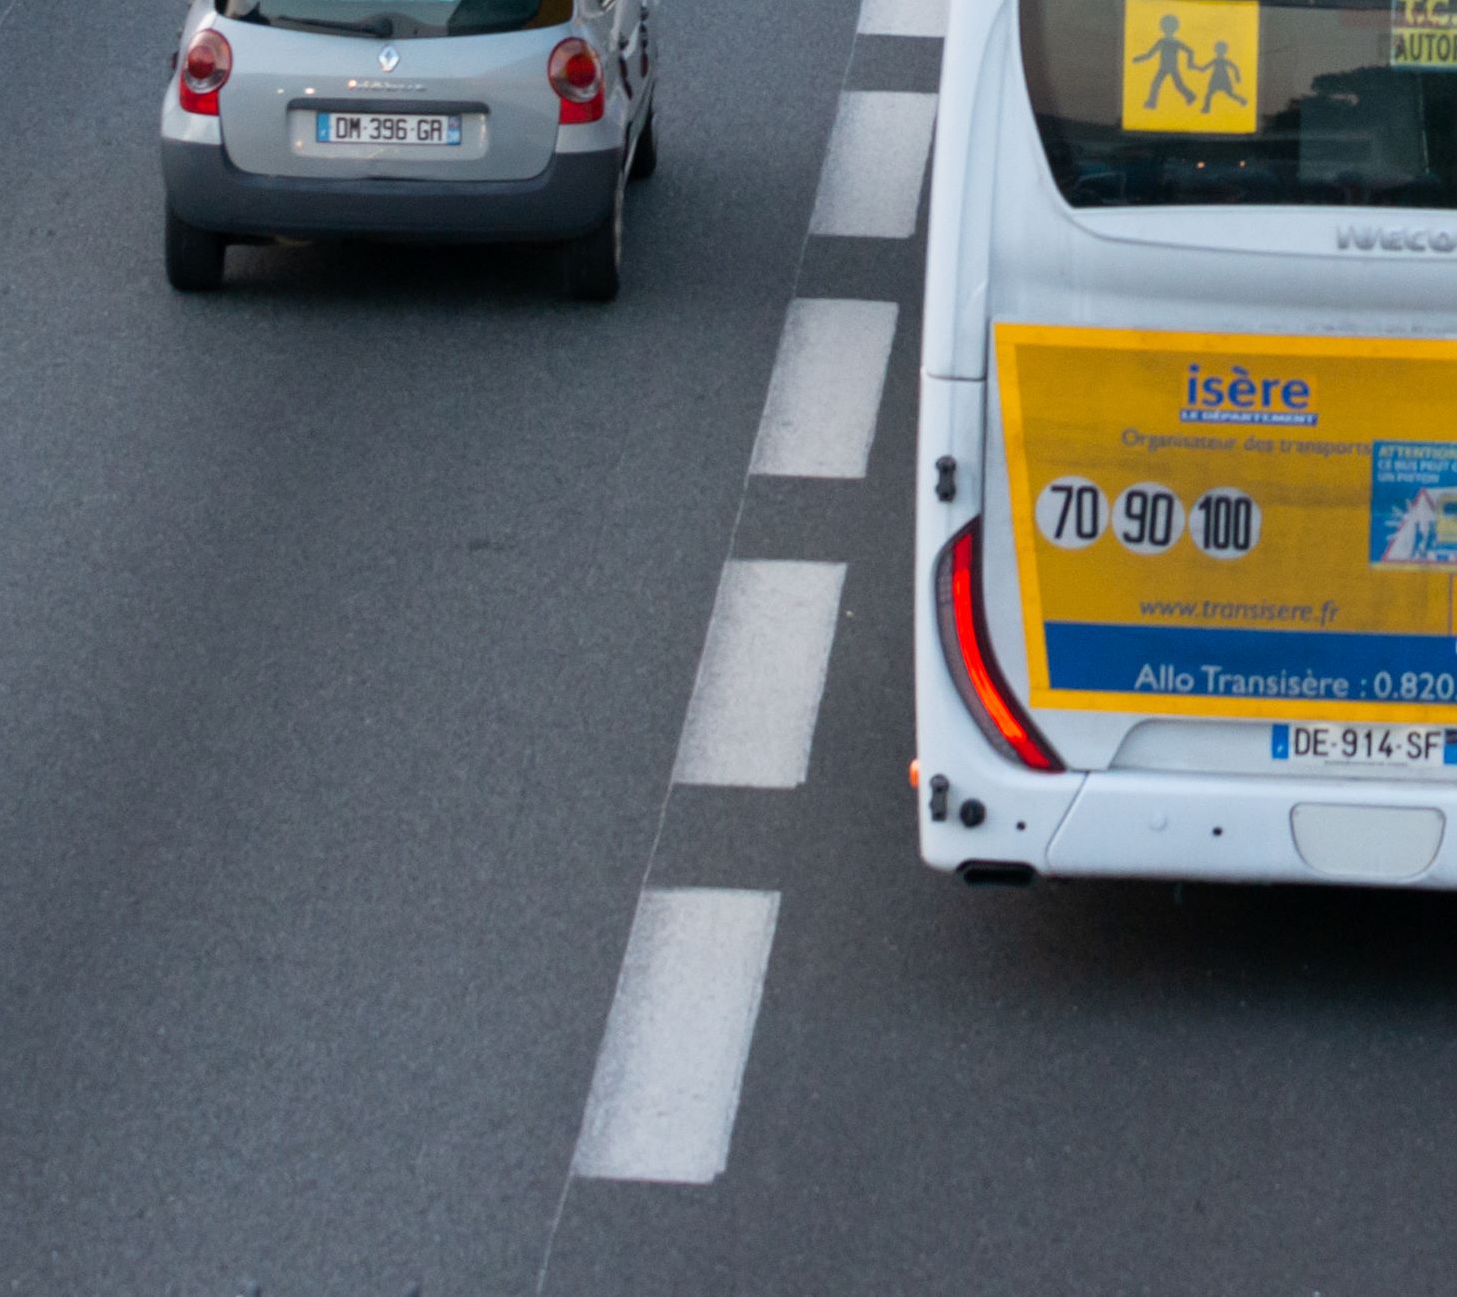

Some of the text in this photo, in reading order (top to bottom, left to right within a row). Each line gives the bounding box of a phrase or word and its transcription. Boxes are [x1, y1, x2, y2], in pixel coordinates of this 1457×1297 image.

[1187, 364, 1311, 408] isère
[1245, 434, 1274, 452] des
[1050, 486, 1100, 540] 70
[1122, 490, 1174, 547] 90
[1198, 495, 1253, 551] 100
[1135, 664, 1194, 691] Allo
[1200, 665, 1349, 697] Transisère
